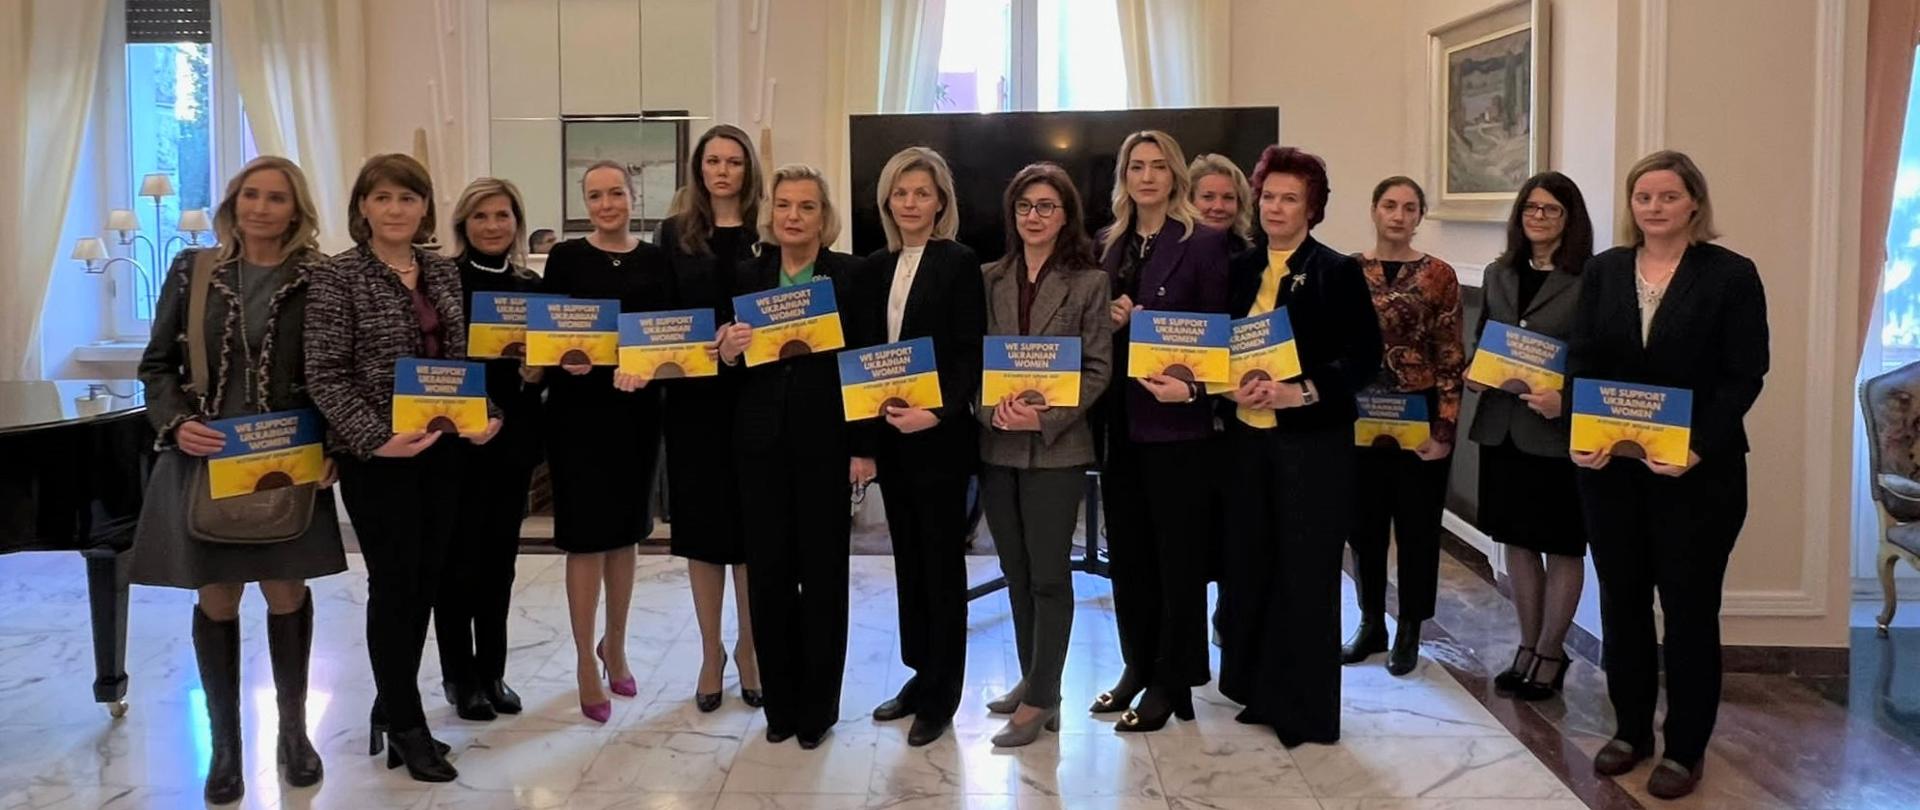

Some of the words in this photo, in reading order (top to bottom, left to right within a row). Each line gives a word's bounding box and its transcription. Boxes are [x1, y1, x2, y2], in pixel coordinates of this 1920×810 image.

[756, 297, 771, 306] WE
[772, 289, 811, 303] SUPPORT
[563, 304, 600, 312] SUPPORT
[761, 299, 811, 314] UKRAINIAN
[502, 313, 526, 321] WOM
[770, 308, 806, 321] WOMEN
[558, 320, 592, 328] WOMEN
[640, 319, 654, 327] WE
[656, 316, 694, 326] SUPPORT
[1153, 317, 1167, 325] WE
[1169, 319, 1208, 327] SUPPORT
[1155, 326, 1205, 336] UKRAINIAN
[1230, 329, 1270, 344] KRAINIAN
[650, 333, 686, 342] WOMEN
[1162, 334, 1198, 343] WOMEN
[1505, 330, 1521, 341] WE
[1521, 335, 1561, 353] SUPPORT
[1004, 343, 1019, 351] WE
[1020, 343, 1060, 351] SUPPORT
[861, 353, 874, 362] WE
[875, 346, 912, 358] SUPPORT
[1008, 351, 1057, 360] UKRAINIAN
[1511, 351, 1546, 366] WOMEN
[864, 356, 911, 370] UKRAINIAN
[1015, 359, 1050, 369] WOMEN
[416, 366, 429, 374] WE
[431, 366, 467, 376] SUPPORT
[872, 367, 906, 377] WOMEN
[425, 384, 457, 393] WOMEN
[1599, 386, 1618, 396] WE
[1618, 389, 1667, 402] SUPPORT
[1603, 396, 1662, 411] UKRAINIAN
[1611, 406, 1653, 419] WOMEN
[235, 423, 253, 433] WE
[254, 416, 298, 431] SUPPORT
[249, 437, 290, 450] WOMEN
